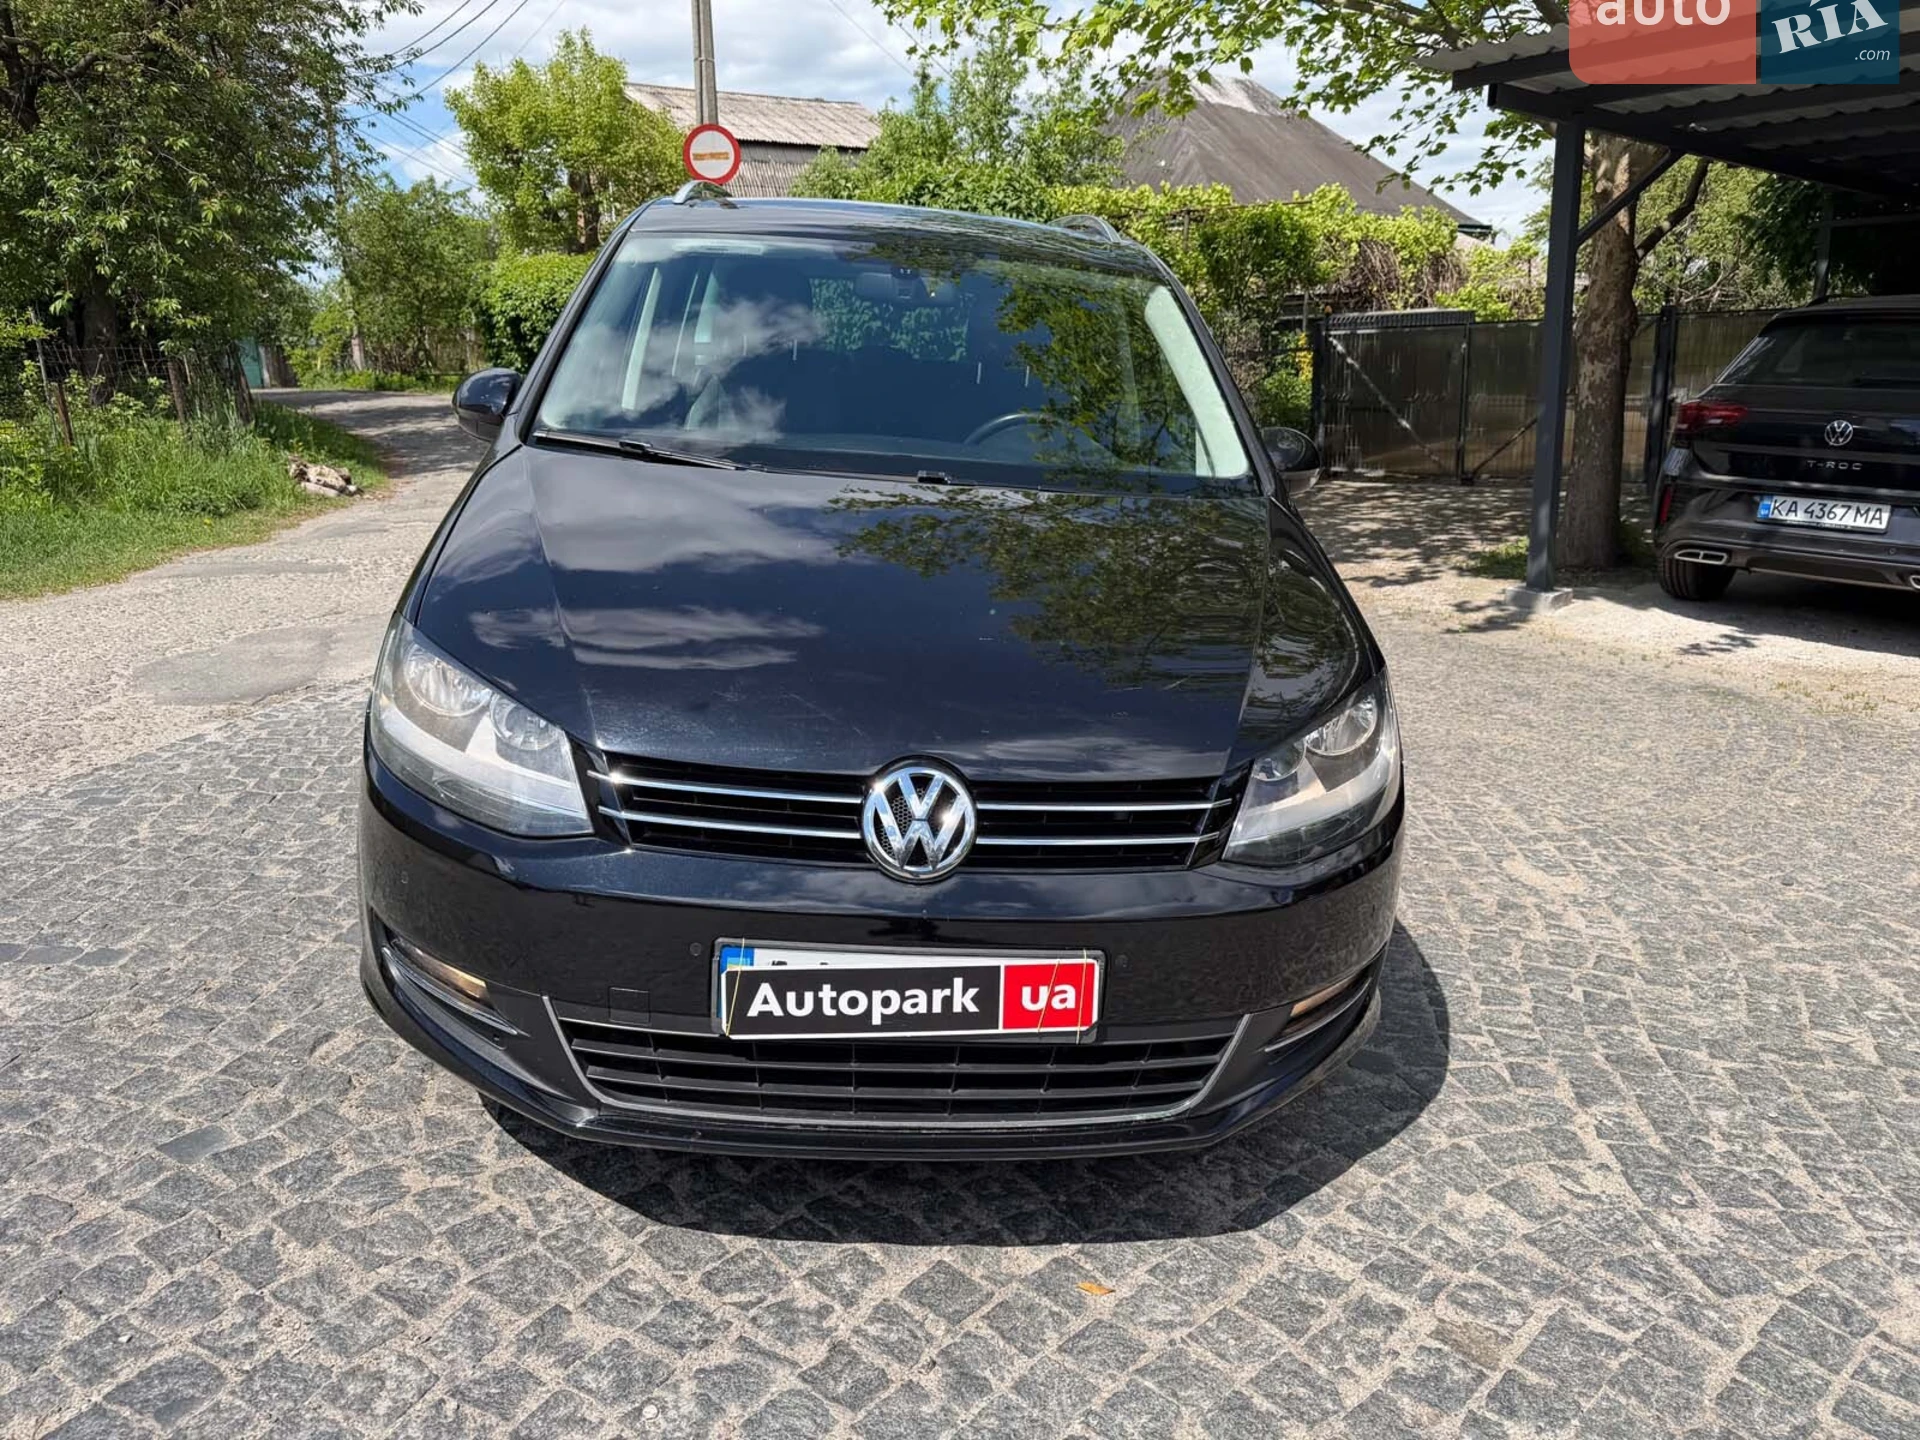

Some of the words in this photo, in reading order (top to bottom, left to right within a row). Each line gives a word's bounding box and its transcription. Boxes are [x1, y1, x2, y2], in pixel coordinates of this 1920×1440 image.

[1807, 460, 1863, 471] T-ROC
[1771, 499, 1799, 517] KA
[1804, 501, 1852, 522] 4367
[1853, 505, 1883, 525] MA
[746, 977, 980, 1025] Autopark
[1021, 983, 1077, 1012] ua
